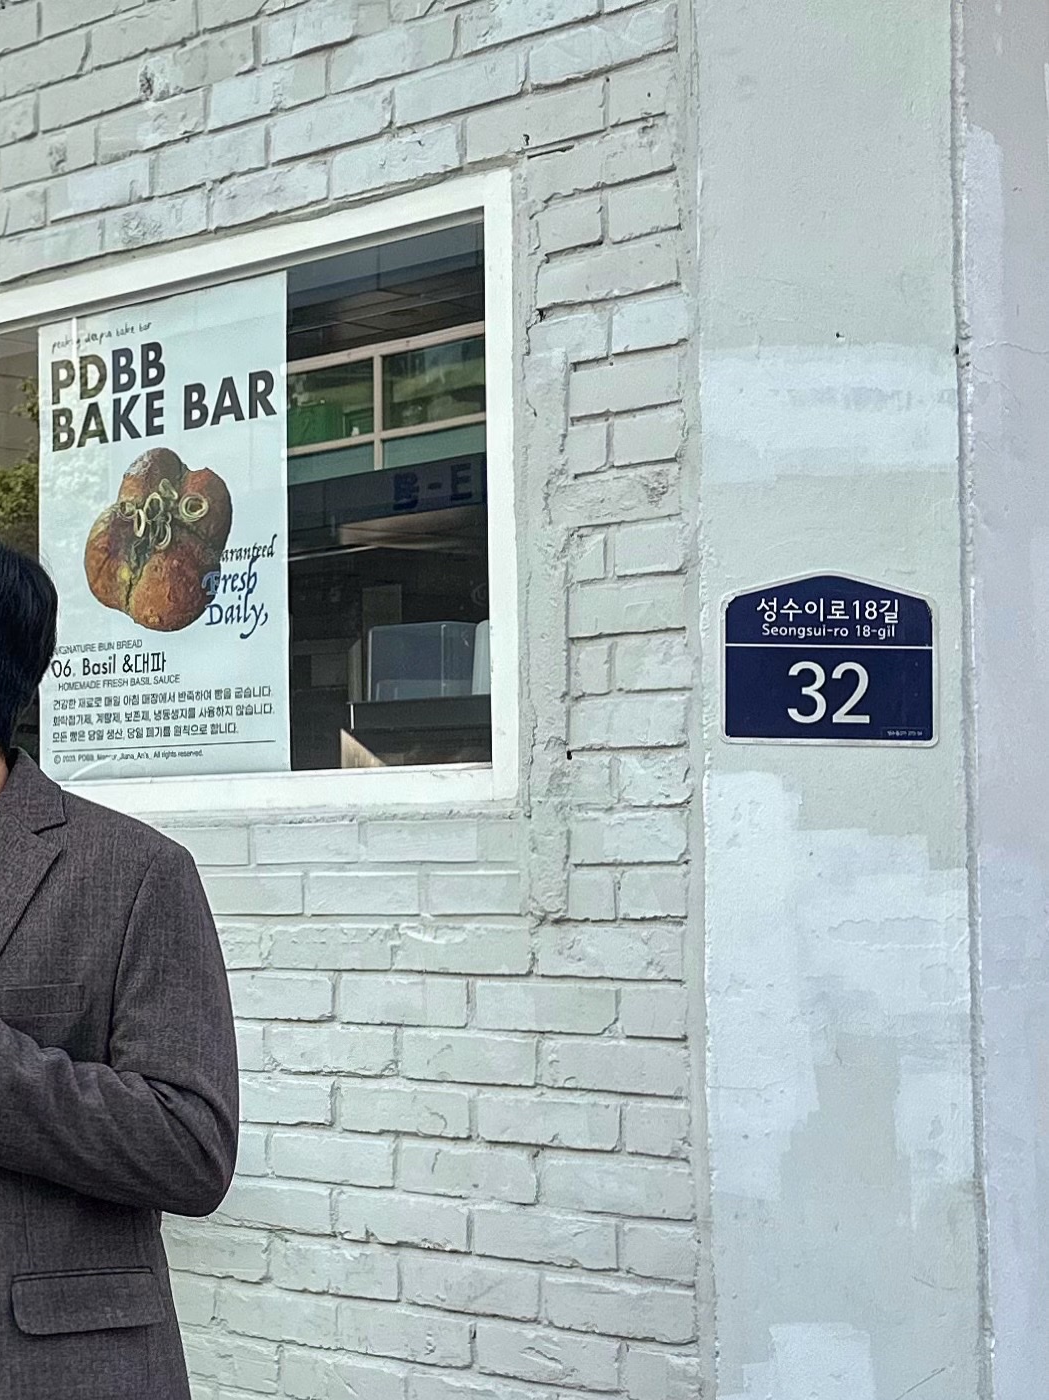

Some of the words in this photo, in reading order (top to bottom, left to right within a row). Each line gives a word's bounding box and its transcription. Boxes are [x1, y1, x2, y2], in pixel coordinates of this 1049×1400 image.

[51, 341, 166, 405] PDBB
[52, 389, 165, 453] BAKE
[183, 370, 278, 431] BAR
[201, 558, 258, 596] Fresh
[204, 592, 269, 640] Daily,
[756, 597, 900, 624] 성수이로18길
[761, 623, 849, 639] Seongsui-ro
[855, 624, 896, 640] 18-gil
[97, 641, 115, 652] BUN
[116, 639, 143, 650] BREAD
[82, 653, 117, 676] Basil
[58, 680, 101, 691] HOMEMADE
[102, 678, 129, 689] FRESH
[129, 676, 151, 687] BASIL
[153, 674, 181, 685] SAUCE
[787, 660, 871, 724] 32
[53, 698, 76, 711] 건강한
[198, 705, 233, 718] 사용하지
[52, 731, 68, 743] 모든
